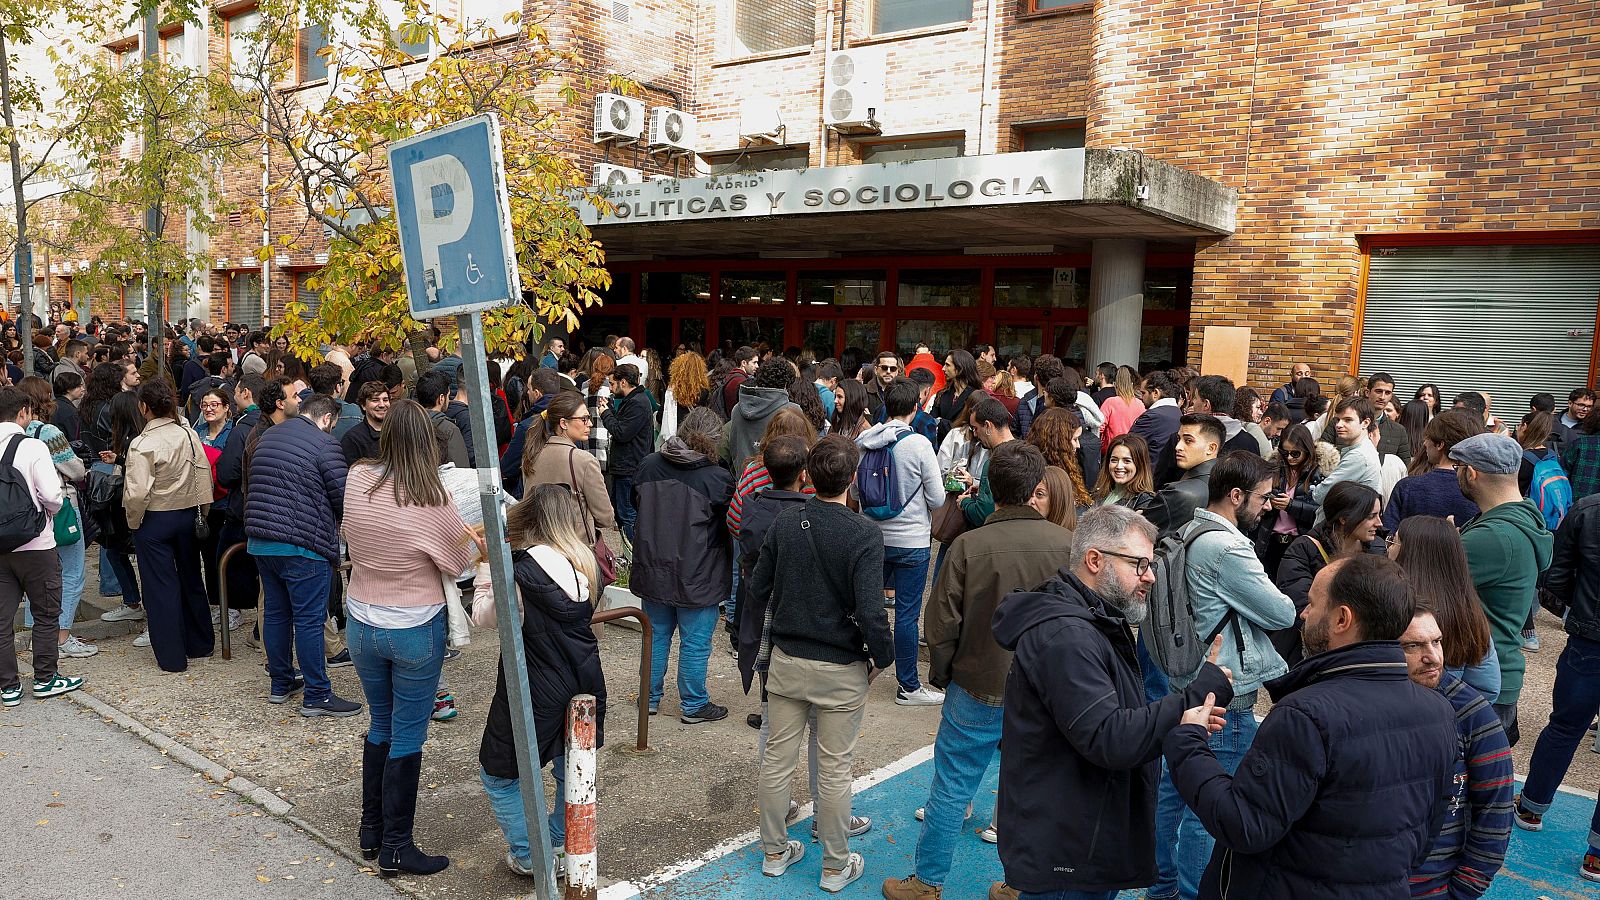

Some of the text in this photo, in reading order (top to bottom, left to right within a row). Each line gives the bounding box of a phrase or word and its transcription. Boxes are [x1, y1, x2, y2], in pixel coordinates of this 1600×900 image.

[664, 186, 681, 194] DE
[705, 179, 759, 190] MADRID
[765, 191, 786, 208] Y
[803, 175, 1053, 206] SOCIOLOGIA
[410, 154, 474, 290] P
